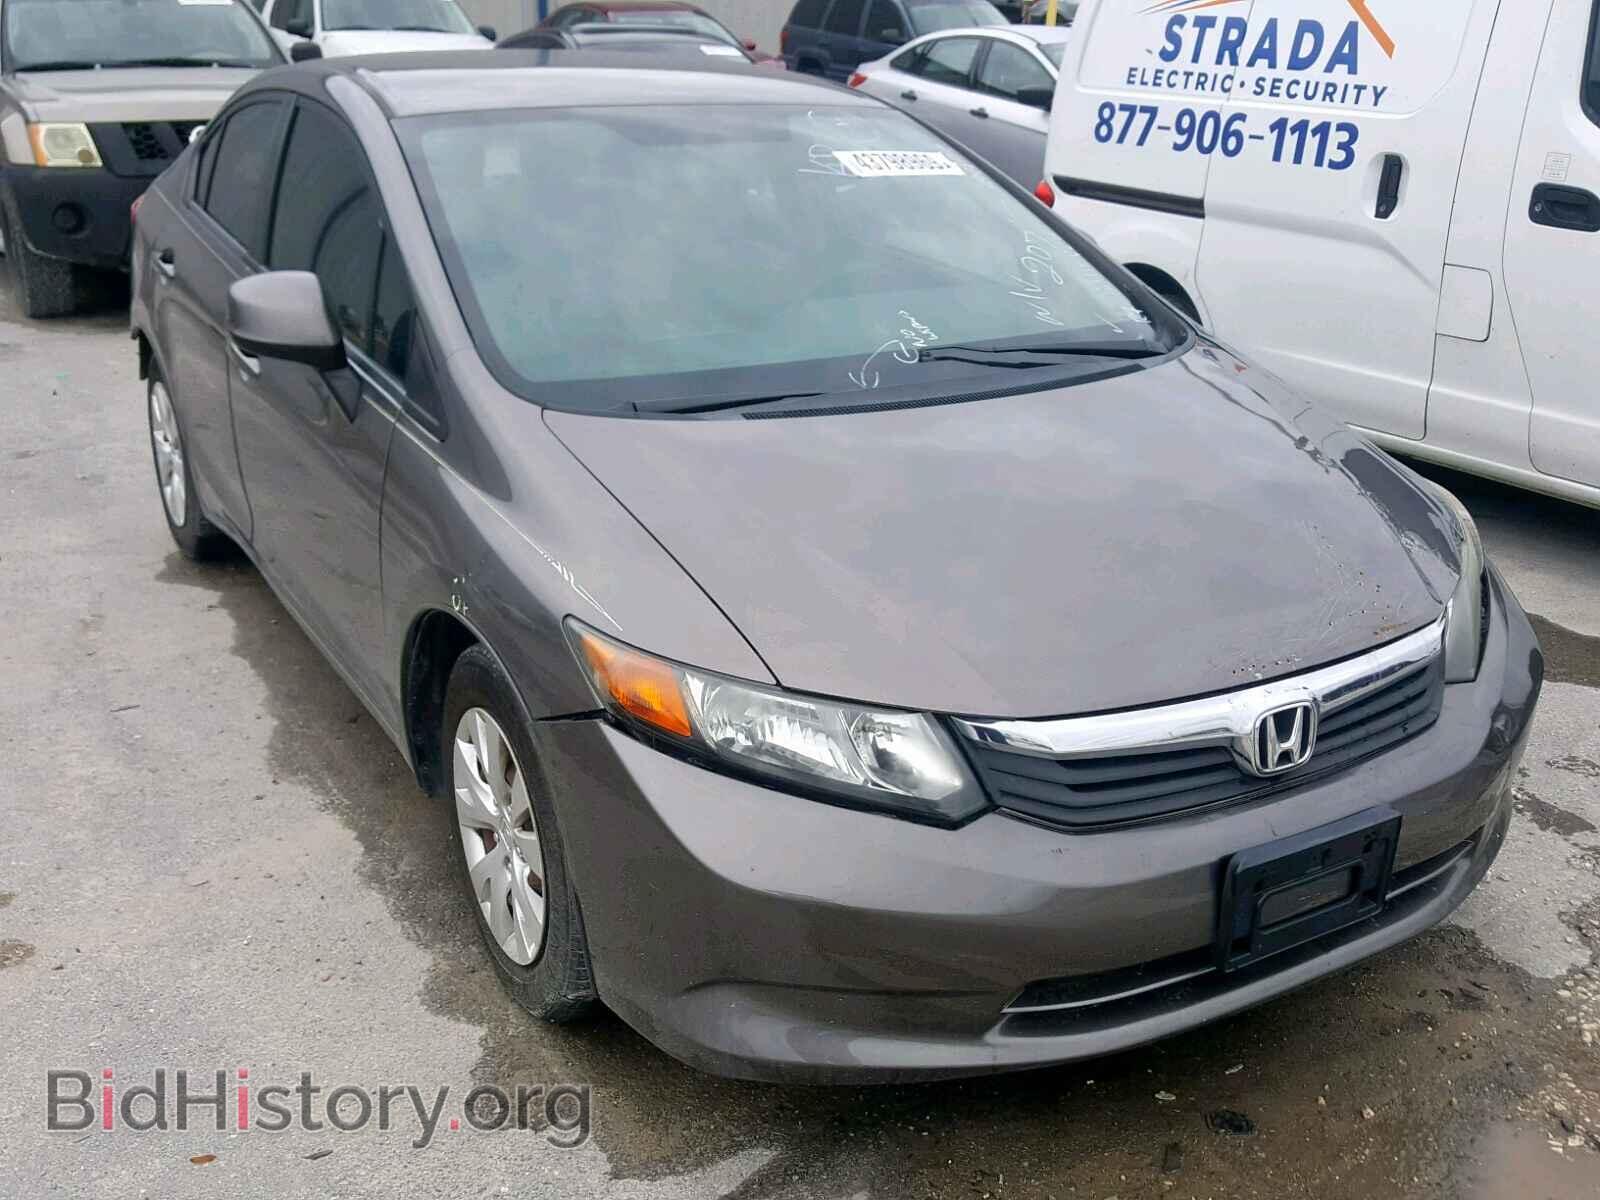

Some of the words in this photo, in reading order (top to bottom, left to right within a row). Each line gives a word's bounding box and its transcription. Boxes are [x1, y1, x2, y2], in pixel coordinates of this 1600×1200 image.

[1158, 13, 1359, 76] STRADA
[1126, 66, 1235, 94] ELECTRIC
[1252, 76, 1388, 107] SECURITY
[1094, 101, 1360, 171] 877-906-1113
